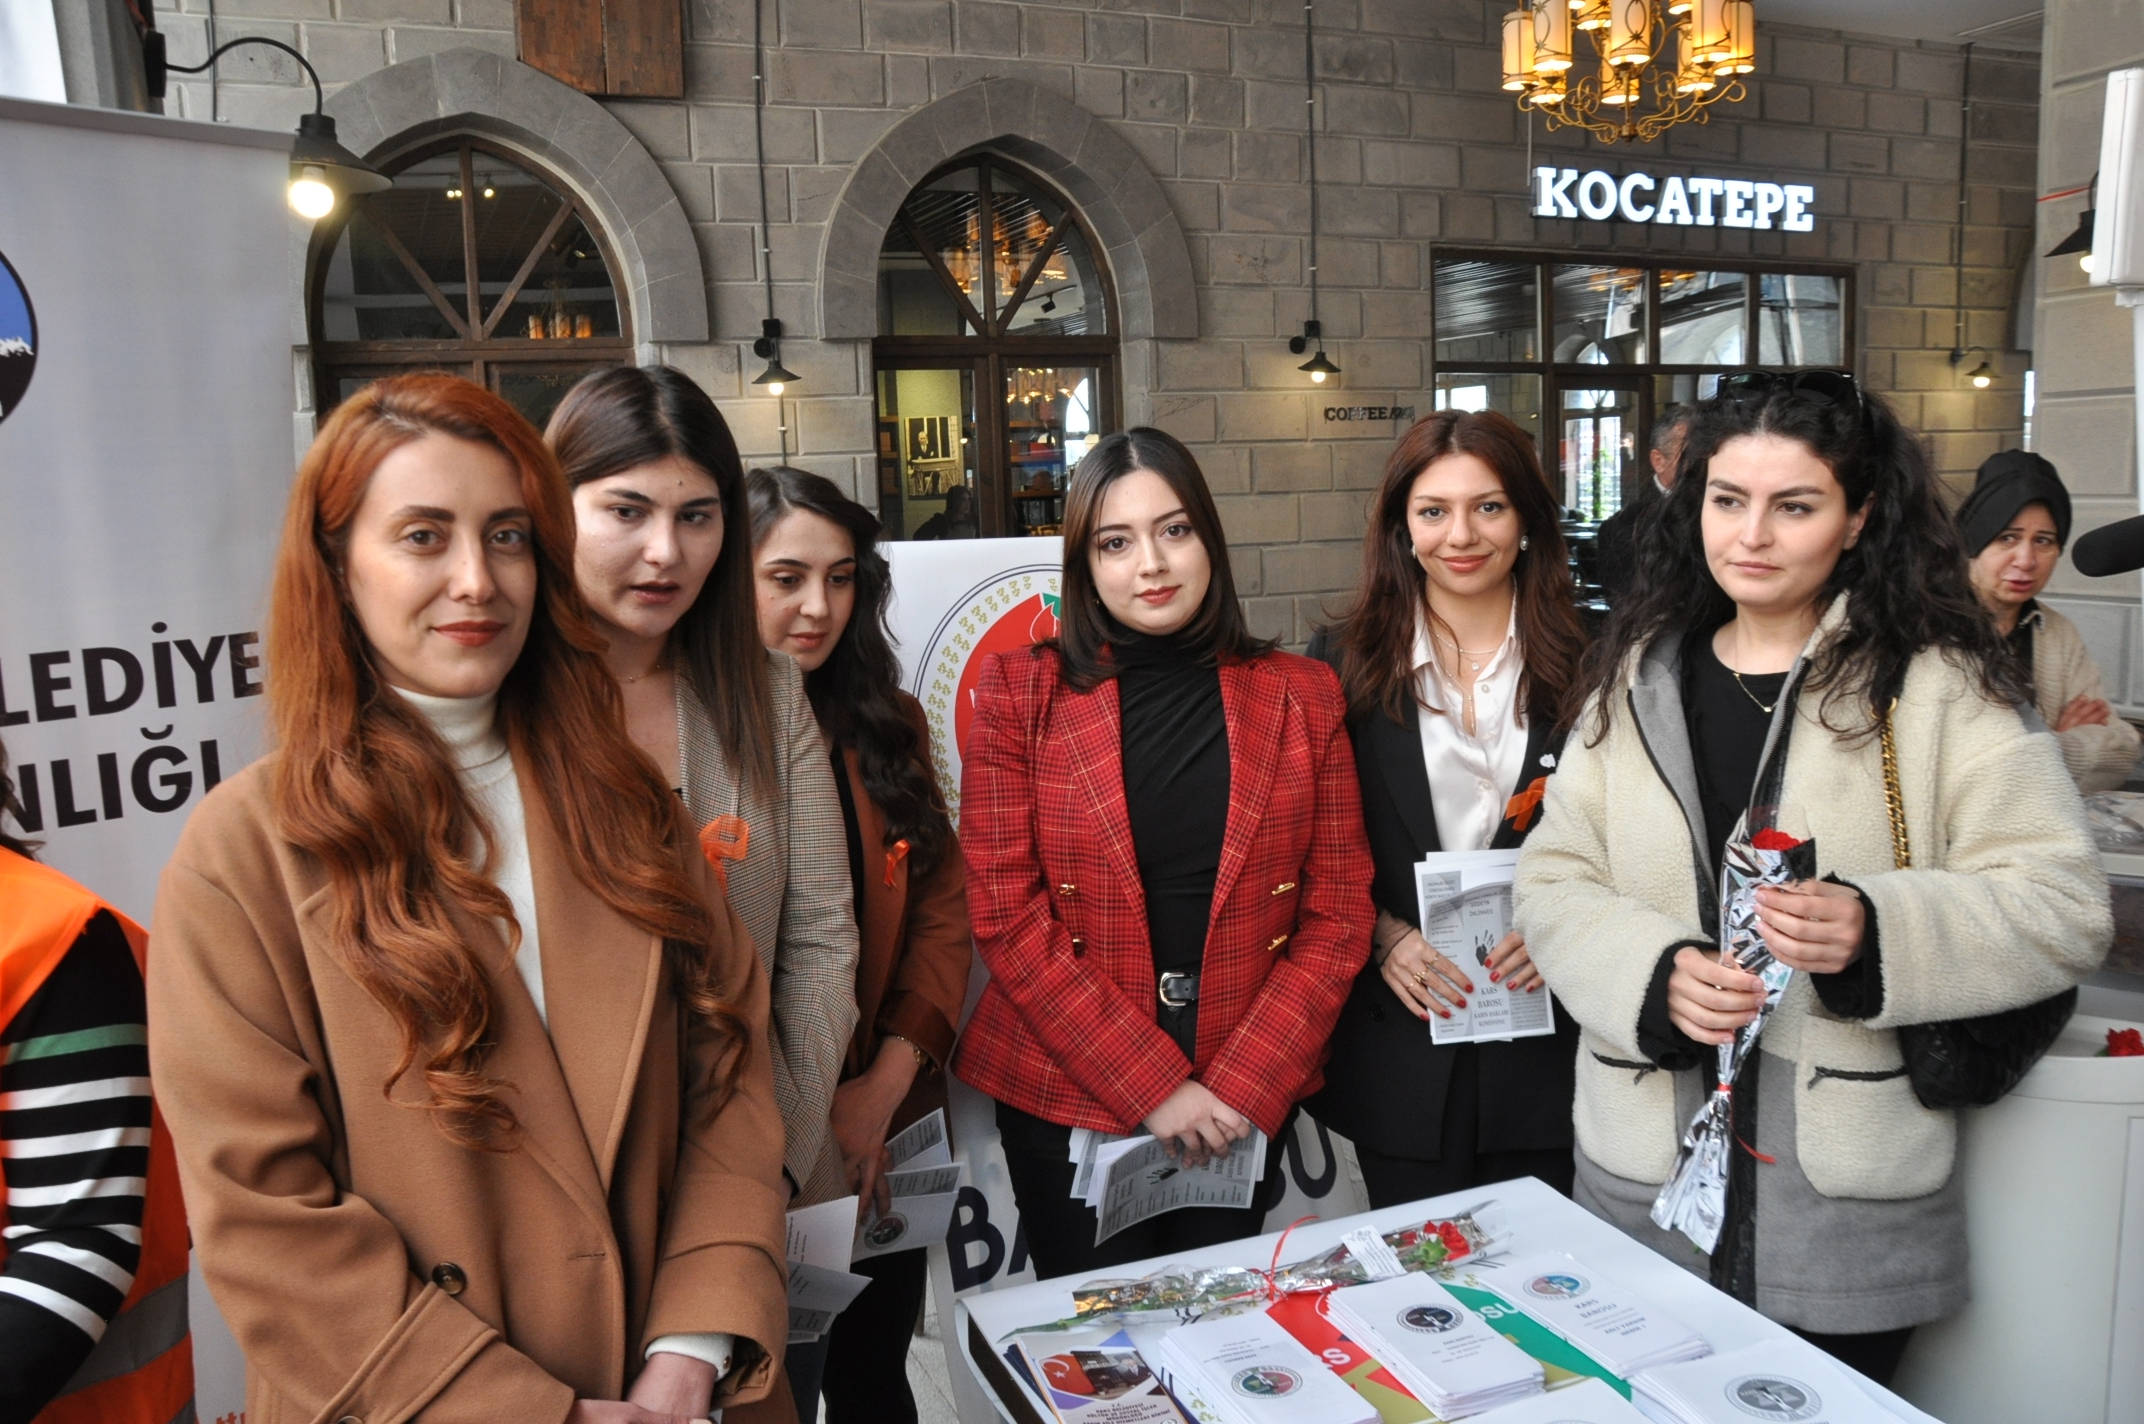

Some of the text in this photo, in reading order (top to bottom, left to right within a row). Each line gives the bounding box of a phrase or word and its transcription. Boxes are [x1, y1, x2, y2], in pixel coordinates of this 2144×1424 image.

[1531, 166, 1814, 232] KOCATEPE
[1324, 406, 1388, 421] COFFEE
[1481, 986, 1498, 995] KARS
[1477, 998, 1503, 1008] BAROSU
[1574, 1299, 1599, 1309] KARS
